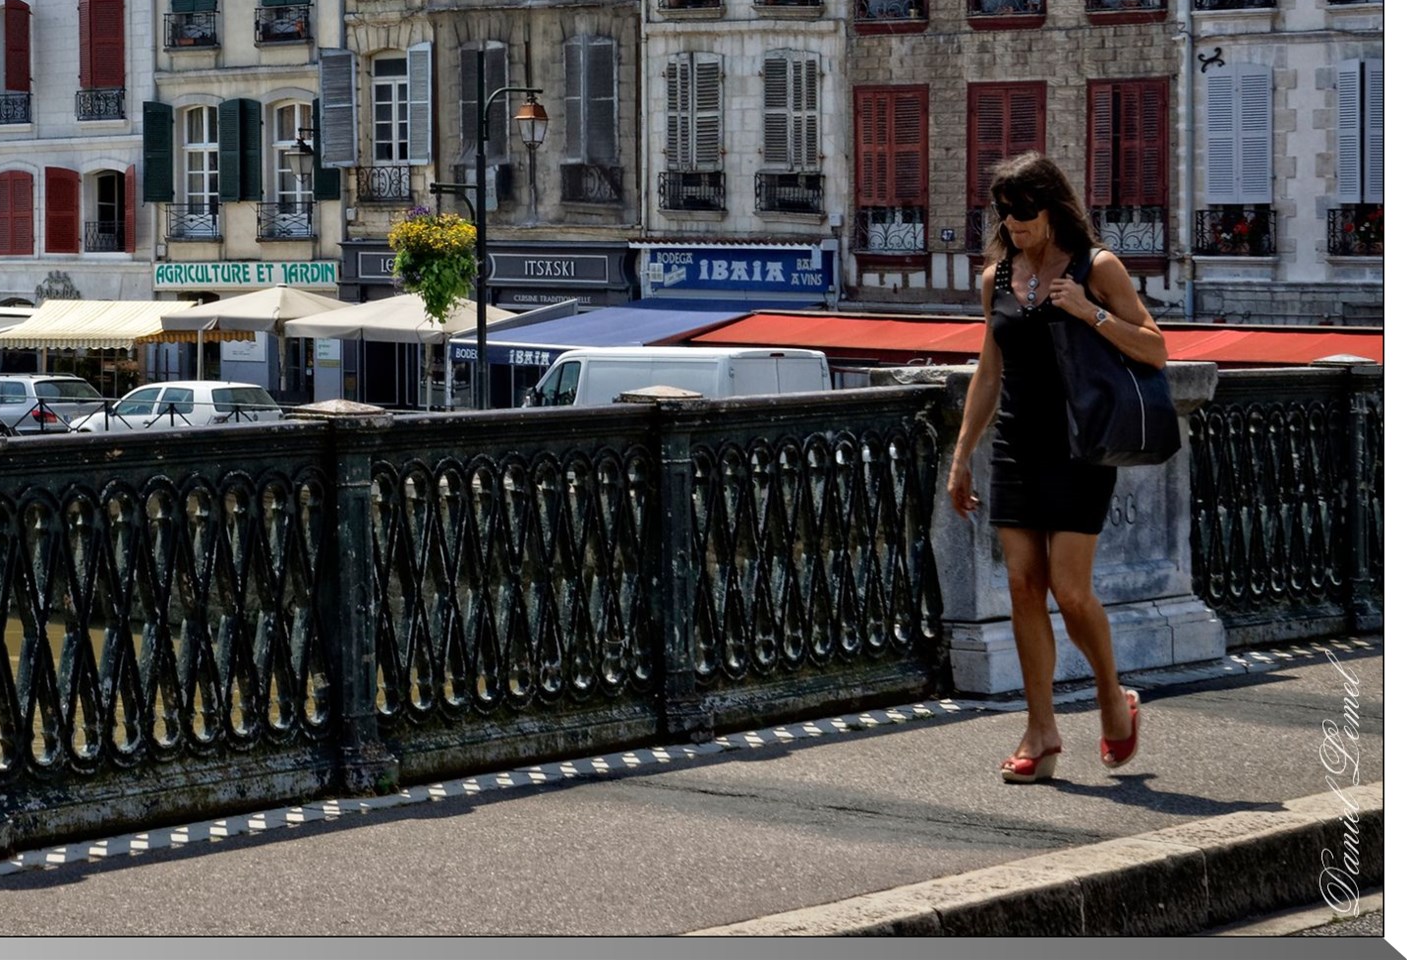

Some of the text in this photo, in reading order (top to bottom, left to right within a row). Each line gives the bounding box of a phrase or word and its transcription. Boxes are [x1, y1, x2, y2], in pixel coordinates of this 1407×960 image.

[657, 252, 694, 264] BODEGA
[156, 263, 335, 284] AGRICULTURE ET JARDIN
[524, 260, 575, 277] ITSASKI
[801, 274, 822, 286] VINS
[513, 294, 538, 303] CUISINE
